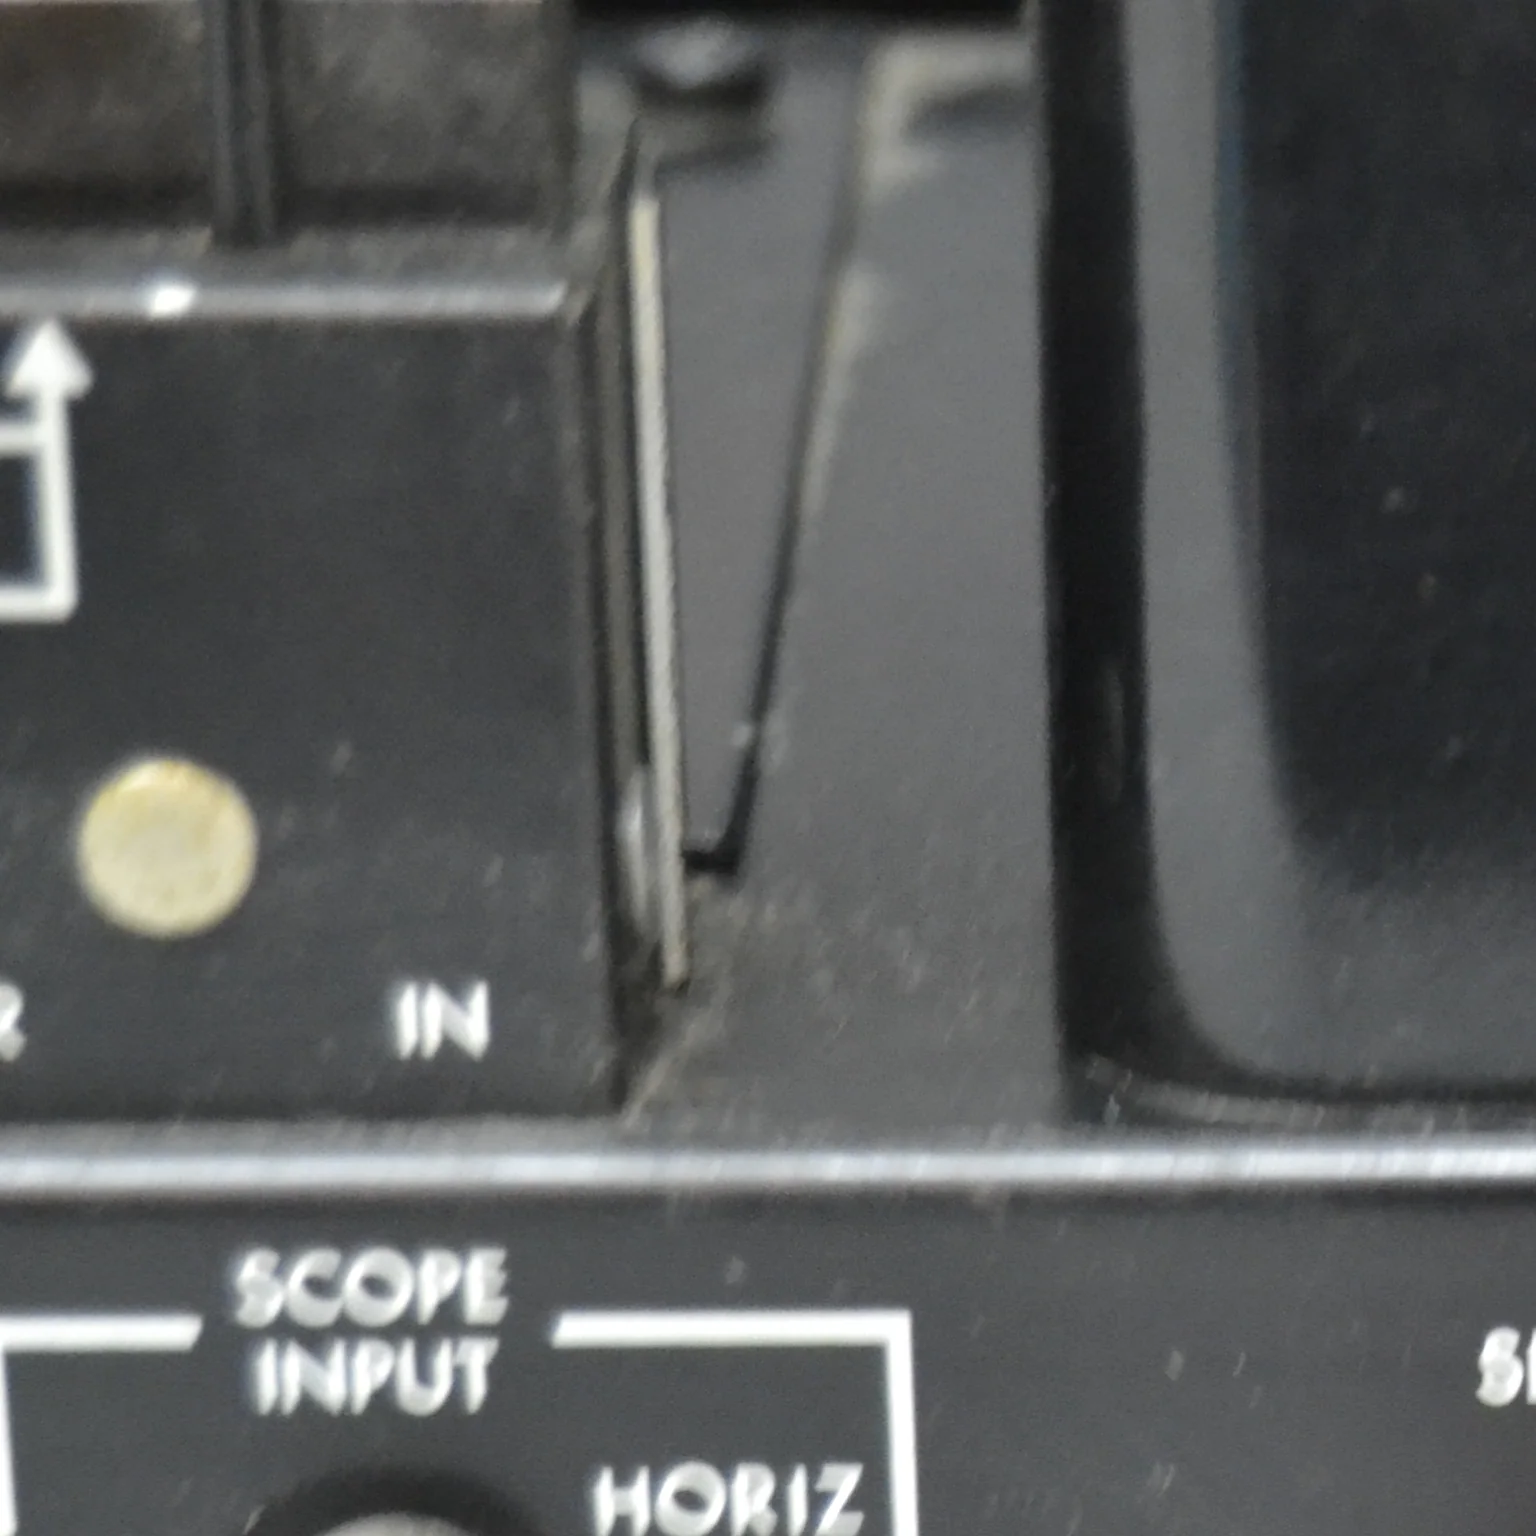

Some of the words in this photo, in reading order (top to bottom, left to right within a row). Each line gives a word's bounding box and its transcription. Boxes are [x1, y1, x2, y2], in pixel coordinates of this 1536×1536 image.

[393, 982, 490, 1059] IN
[234, 1247, 508, 1328] SCOPE
[253, 1337, 499, 1416] INPUT
